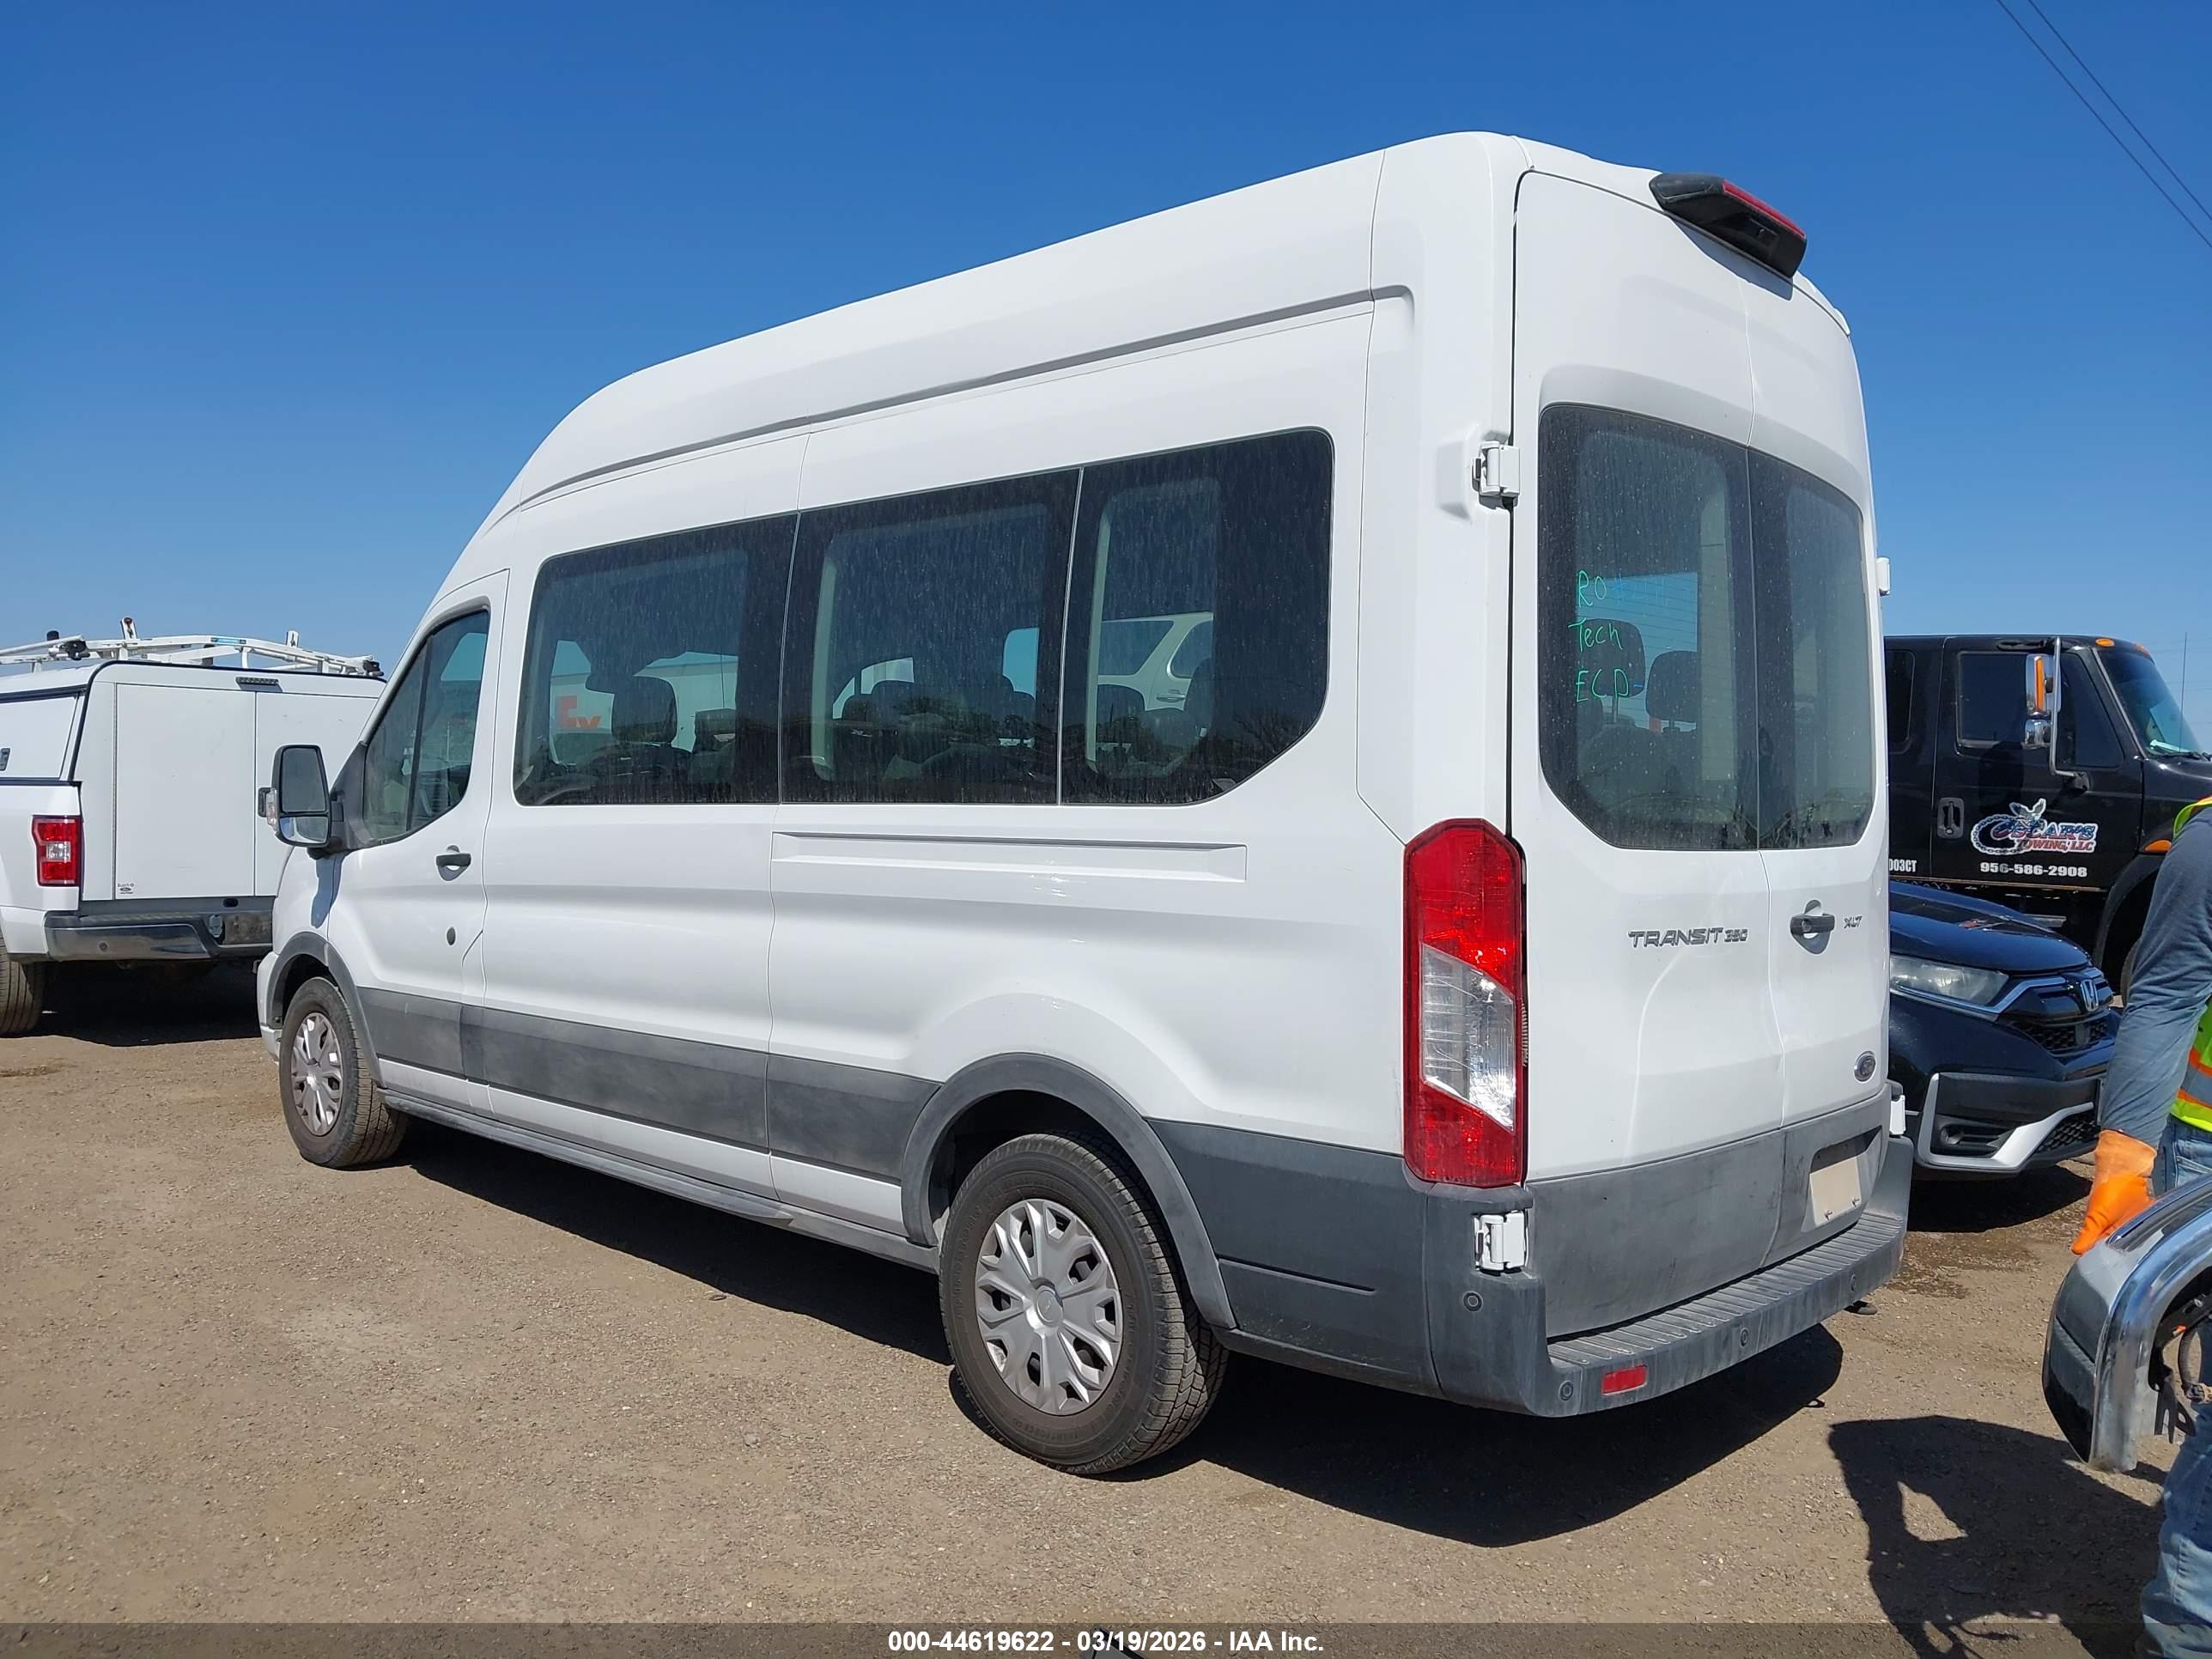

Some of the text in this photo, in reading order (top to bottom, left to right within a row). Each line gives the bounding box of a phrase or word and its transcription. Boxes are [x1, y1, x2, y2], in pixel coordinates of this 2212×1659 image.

[1568, 617, 1623, 653] Tech
[2070, 841, 2094, 851] LLC
[1979, 861, 2088, 878] 956-586-2908
[1844, 915, 1863, 929] XLT
[1628, 927, 1748, 948] TRANSIT 350
